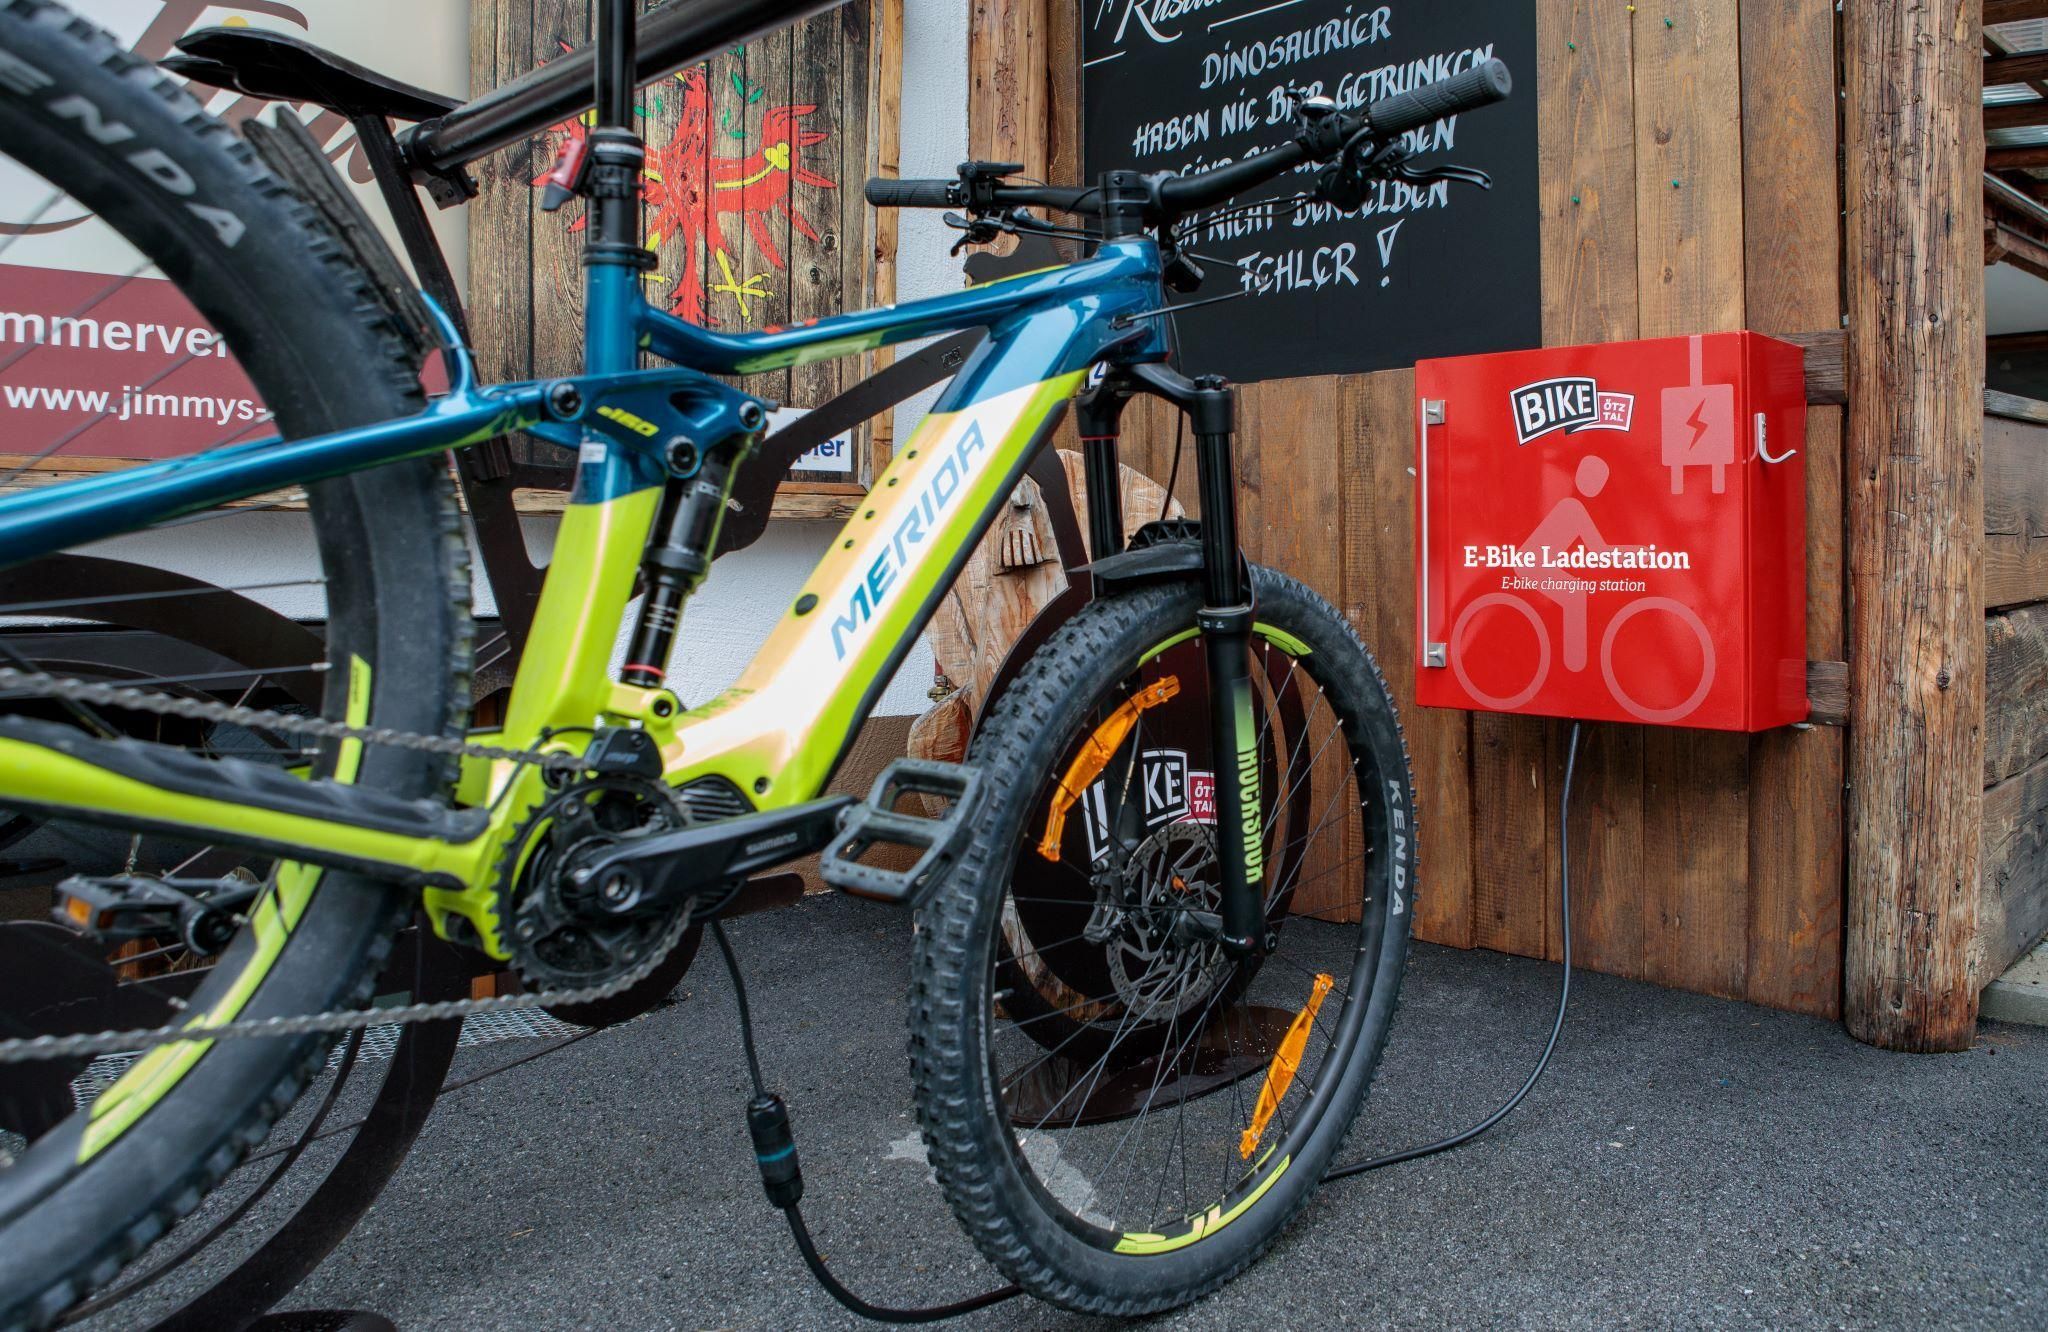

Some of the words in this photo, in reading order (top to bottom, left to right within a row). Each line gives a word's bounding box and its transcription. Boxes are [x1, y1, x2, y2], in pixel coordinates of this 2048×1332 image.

[1132, 107, 1211, 158] HABEN
[1519, 384, 1592, 433] BIKE
[1602, 411, 1624, 422] TAL
[1603, 398, 1626, 412] ÖTZ
[831, 419, 985, 661] MERIDA
[1464, 544, 1536, 569] E-Bike
[1541, 544, 1691, 570] Ladestation
[1501, 576, 1538, 590] E-bike
[1541, 577, 1597, 594] charging
[1599, 578, 1646, 592] station
[1388, 779, 1406, 916] KENDA
